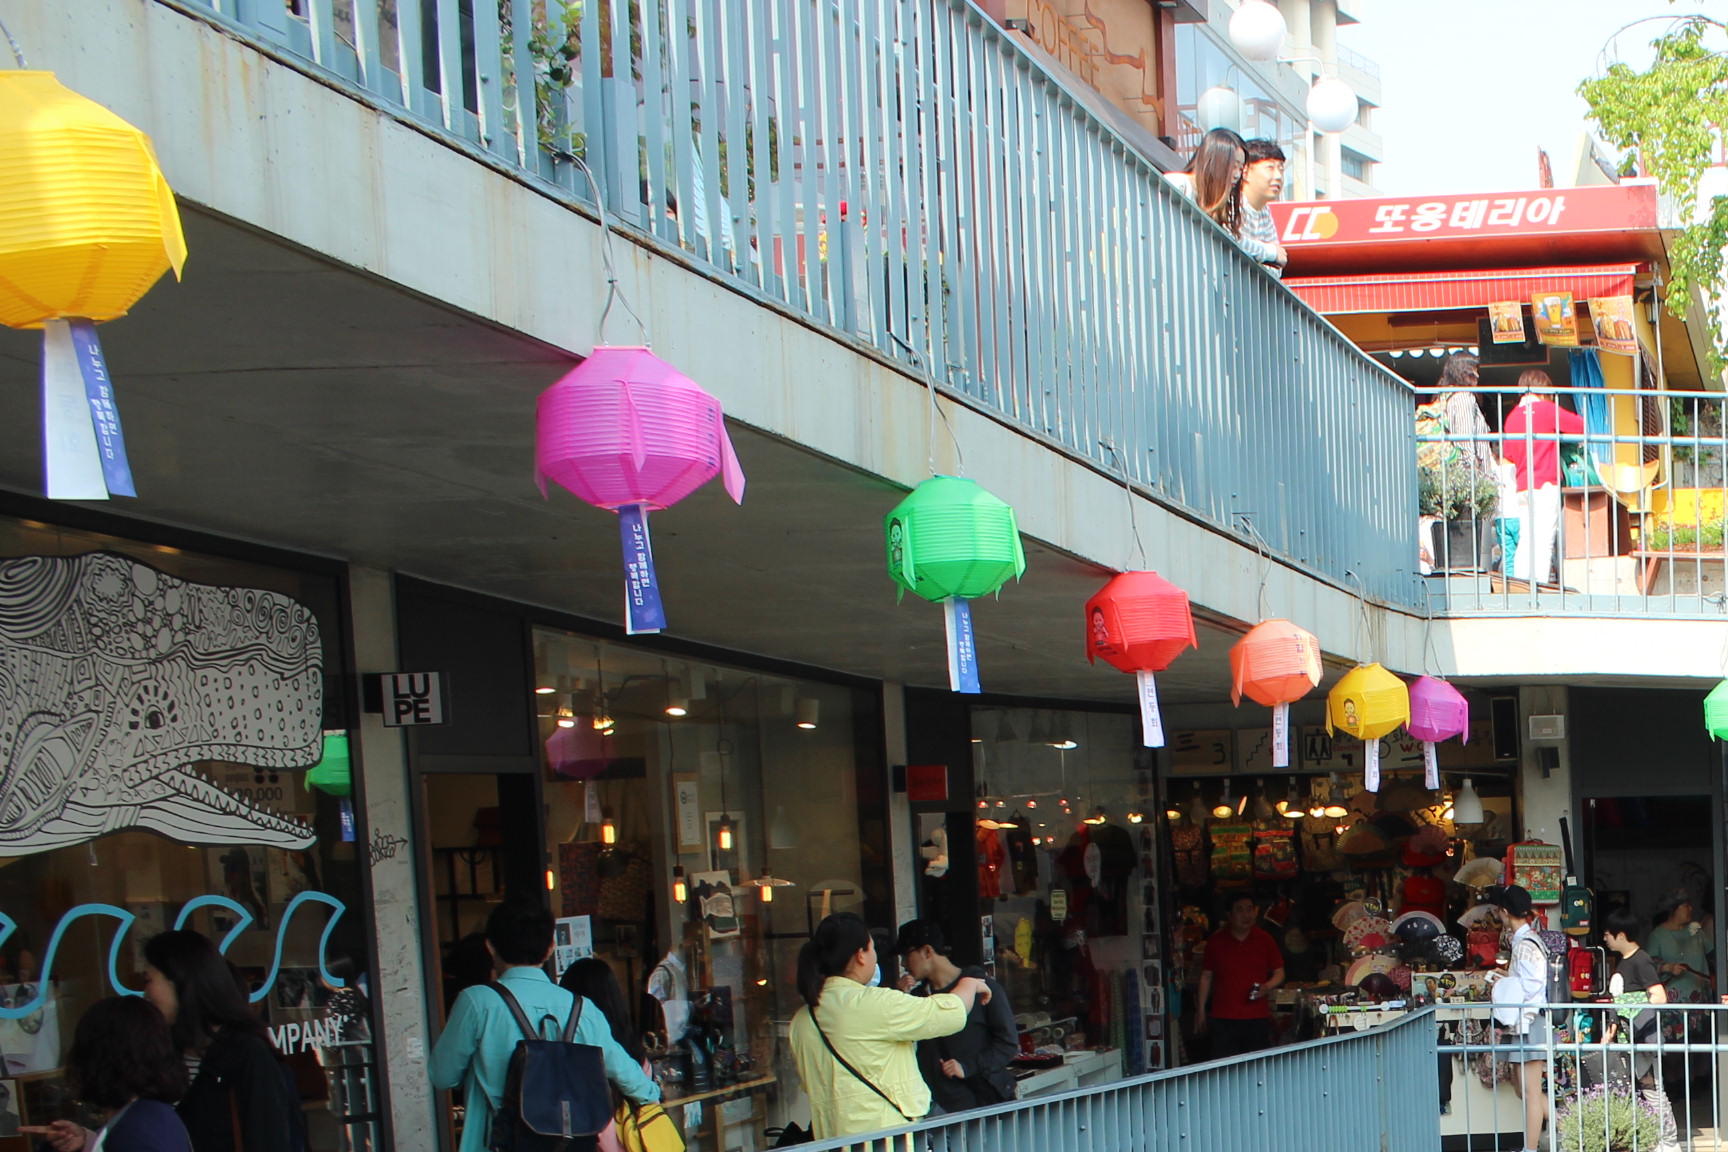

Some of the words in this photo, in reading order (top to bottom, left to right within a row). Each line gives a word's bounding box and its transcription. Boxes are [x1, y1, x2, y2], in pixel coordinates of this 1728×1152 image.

[632, 523, 645, 550] 나누고
[628, 563, 643, 606] 행복합니다
[637, 552, 650, 588] 함께하면
[391, 673, 431, 699] LU
[393, 698, 432, 724] PE
[267, 1013, 347, 1056] MPANY
